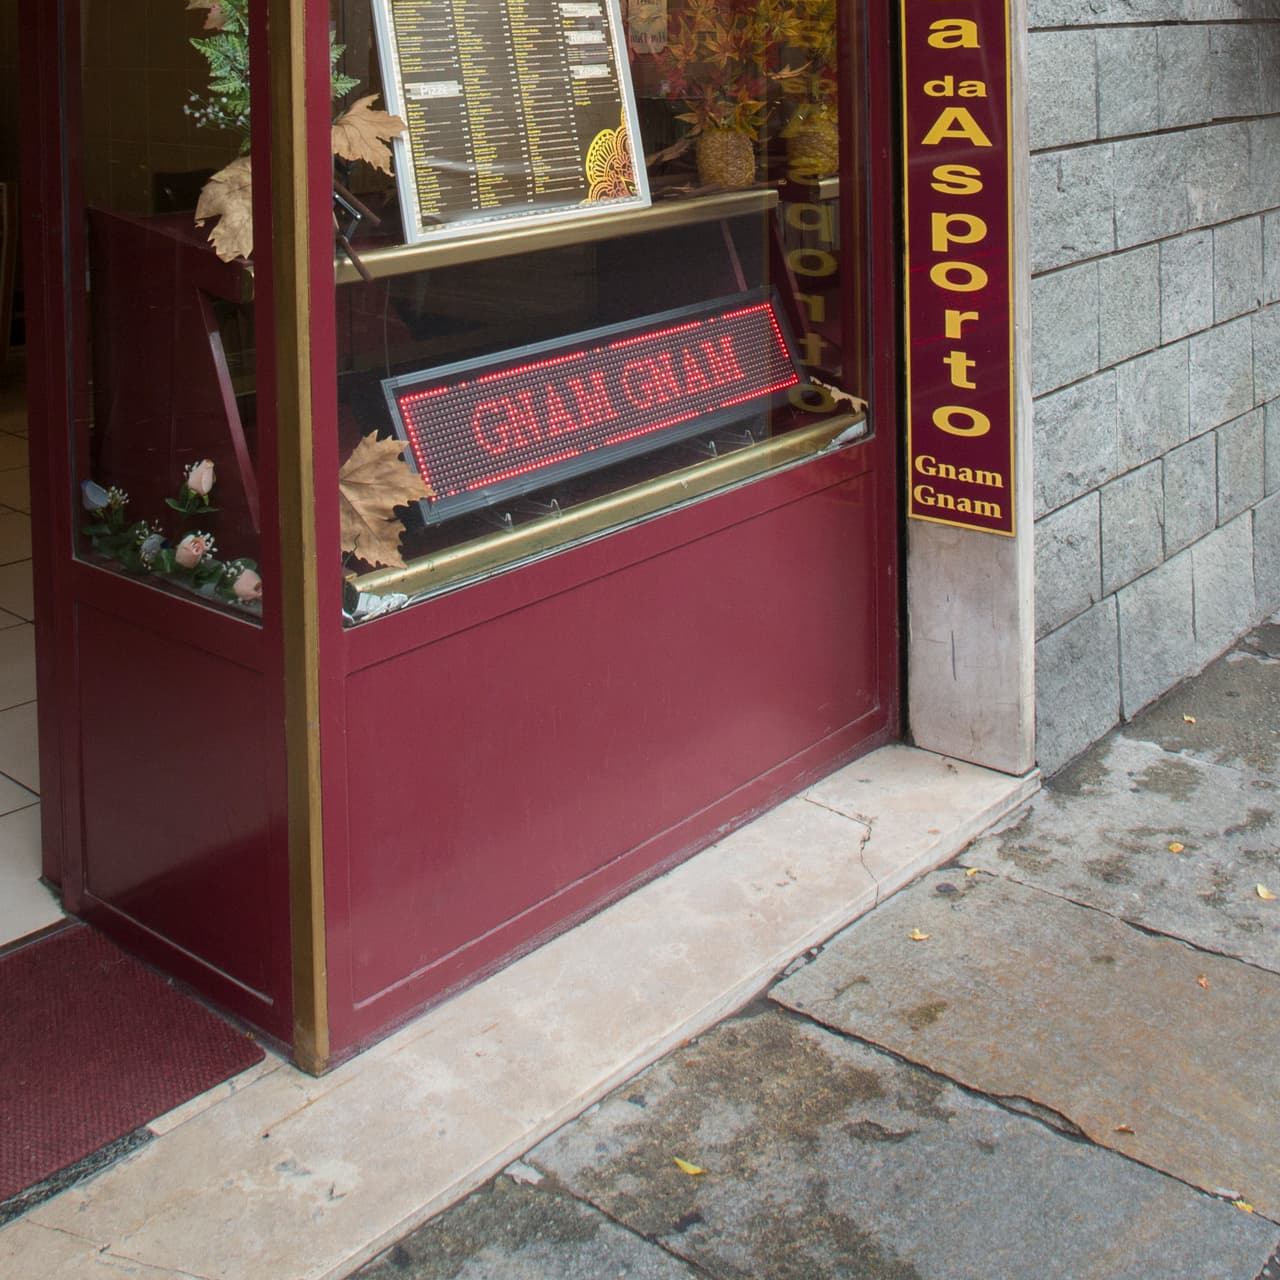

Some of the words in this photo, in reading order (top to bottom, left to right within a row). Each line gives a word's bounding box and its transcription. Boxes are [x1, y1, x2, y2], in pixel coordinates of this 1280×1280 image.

[923, 75, 988, 98] da
[921, 106, 993, 438] Asporto
[473, 371, 618, 454] GNAM
[622, 336, 745, 409] GNAM
[914, 454, 1004, 488] Gnam
[913, 484, 1003, 519] Gnam
